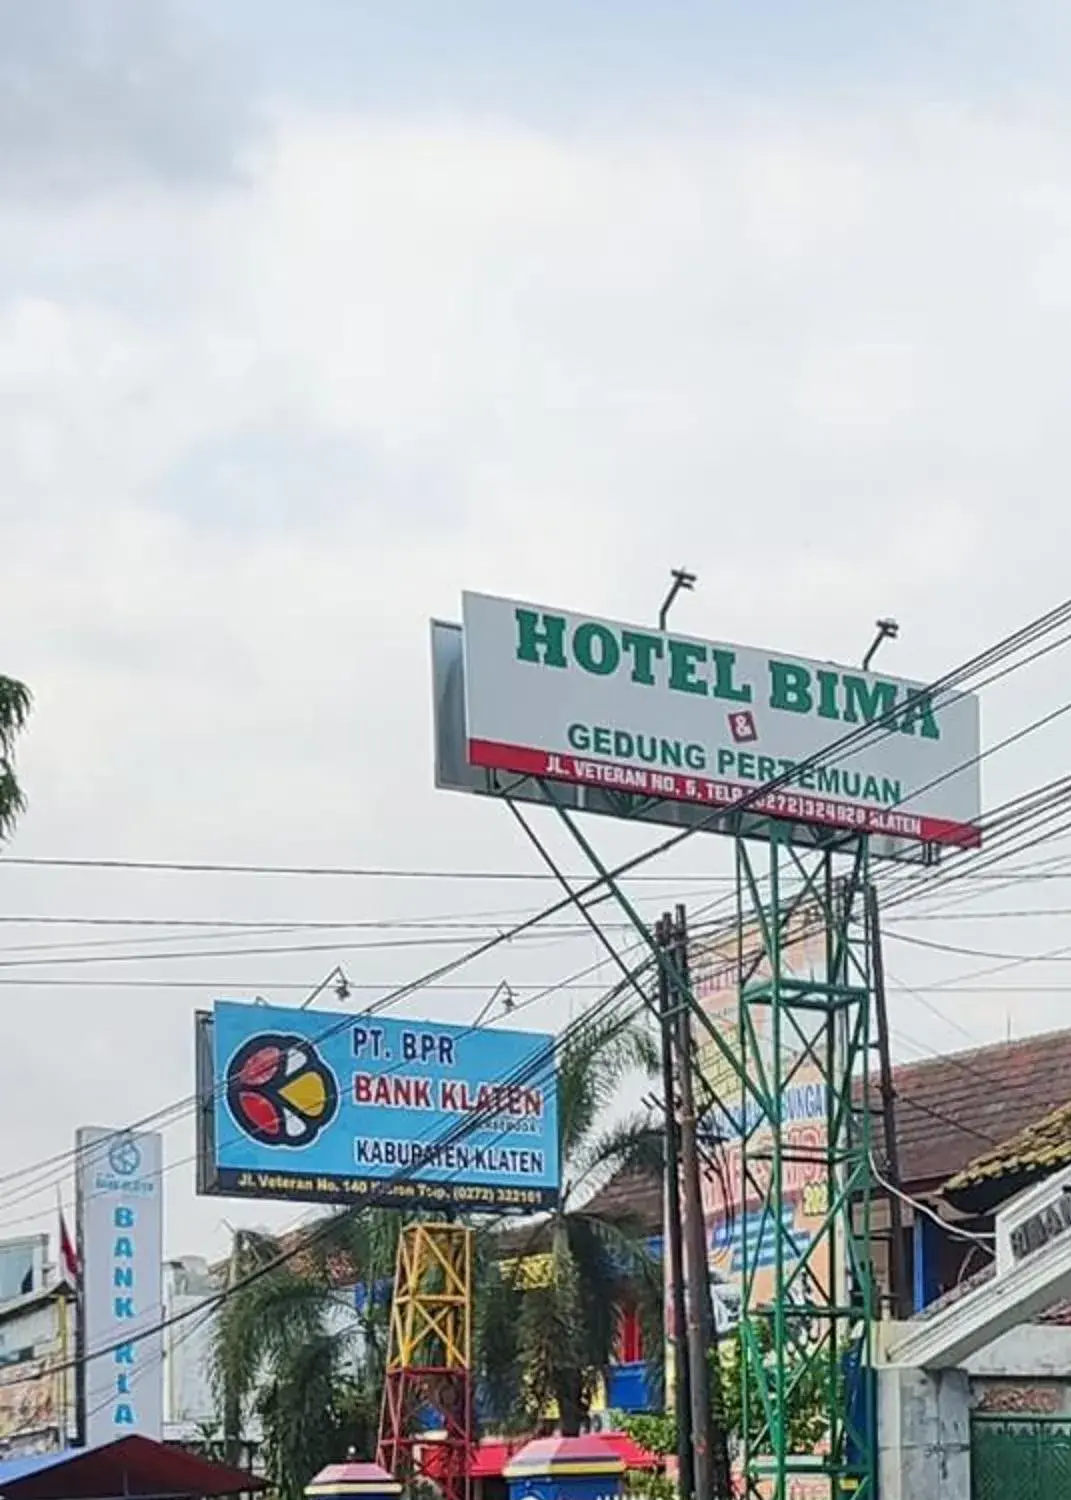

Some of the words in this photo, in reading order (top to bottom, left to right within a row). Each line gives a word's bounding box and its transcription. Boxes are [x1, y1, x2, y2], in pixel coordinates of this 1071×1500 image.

[515, 608, 752, 703] HOTEL
[768, 659, 940, 740] BIMA
[567, 723, 706, 769] GEDUNG
[546, 755, 569, 775] JL.
[572, 761, 647, 788] VETERAN
[352, 1027, 391, 1058] PT.
[403, 1032, 453, 1065] BPR
[354, 1074, 431, 1108] BANK
[441, 1082, 542, 1117] KLATEN
[356, 1138, 468, 1169] KABUPATEN
[475, 1147, 543, 1173] KLATEN
[258, 1174, 313, 1190] Veteran
[317, 1177, 341, 1192] No.
[113, 1206, 135, 1319] BANK
[113, 1343, 135, 1437] KLA
